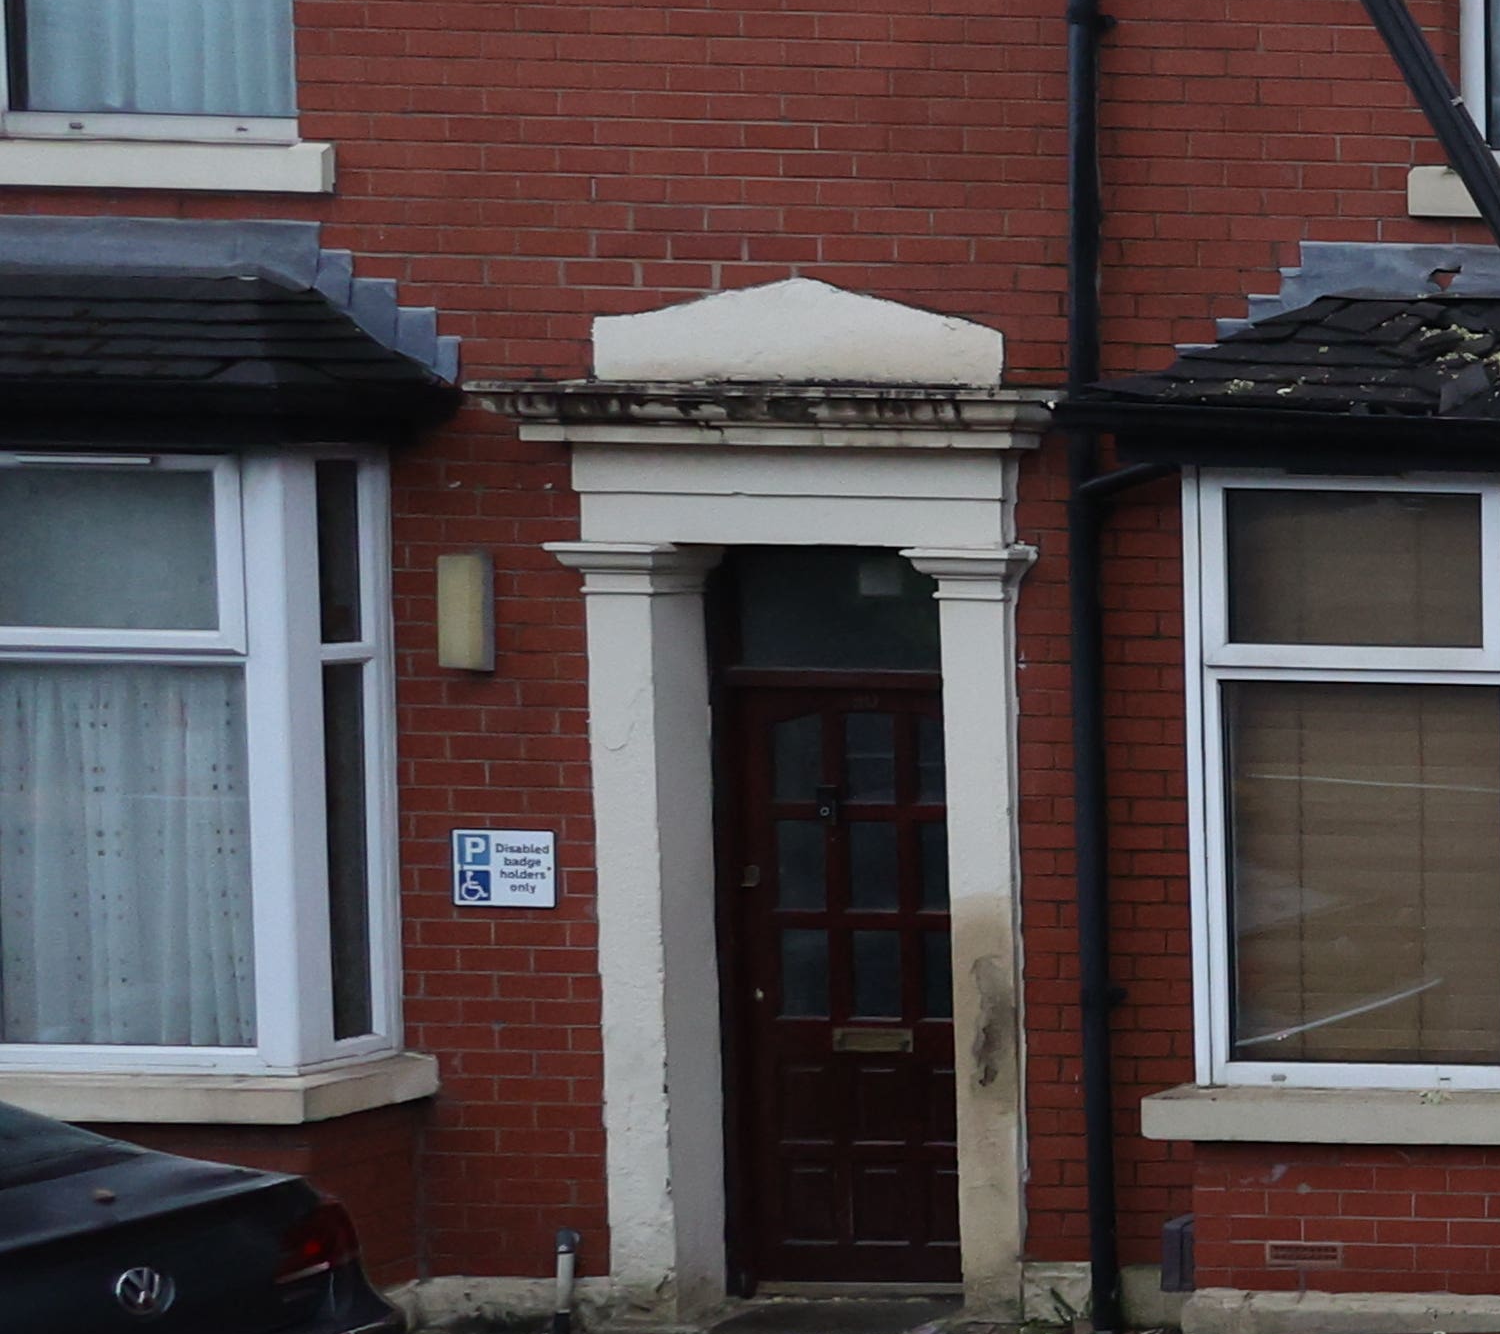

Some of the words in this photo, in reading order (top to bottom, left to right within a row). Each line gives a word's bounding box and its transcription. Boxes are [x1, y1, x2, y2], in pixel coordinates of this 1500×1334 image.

[464, 836, 486, 863] P
[495, 843, 550, 854] Disabled
[504, 857, 542, 868] badge
[500, 870, 546, 879] holders
[509, 883, 536, 894] only
